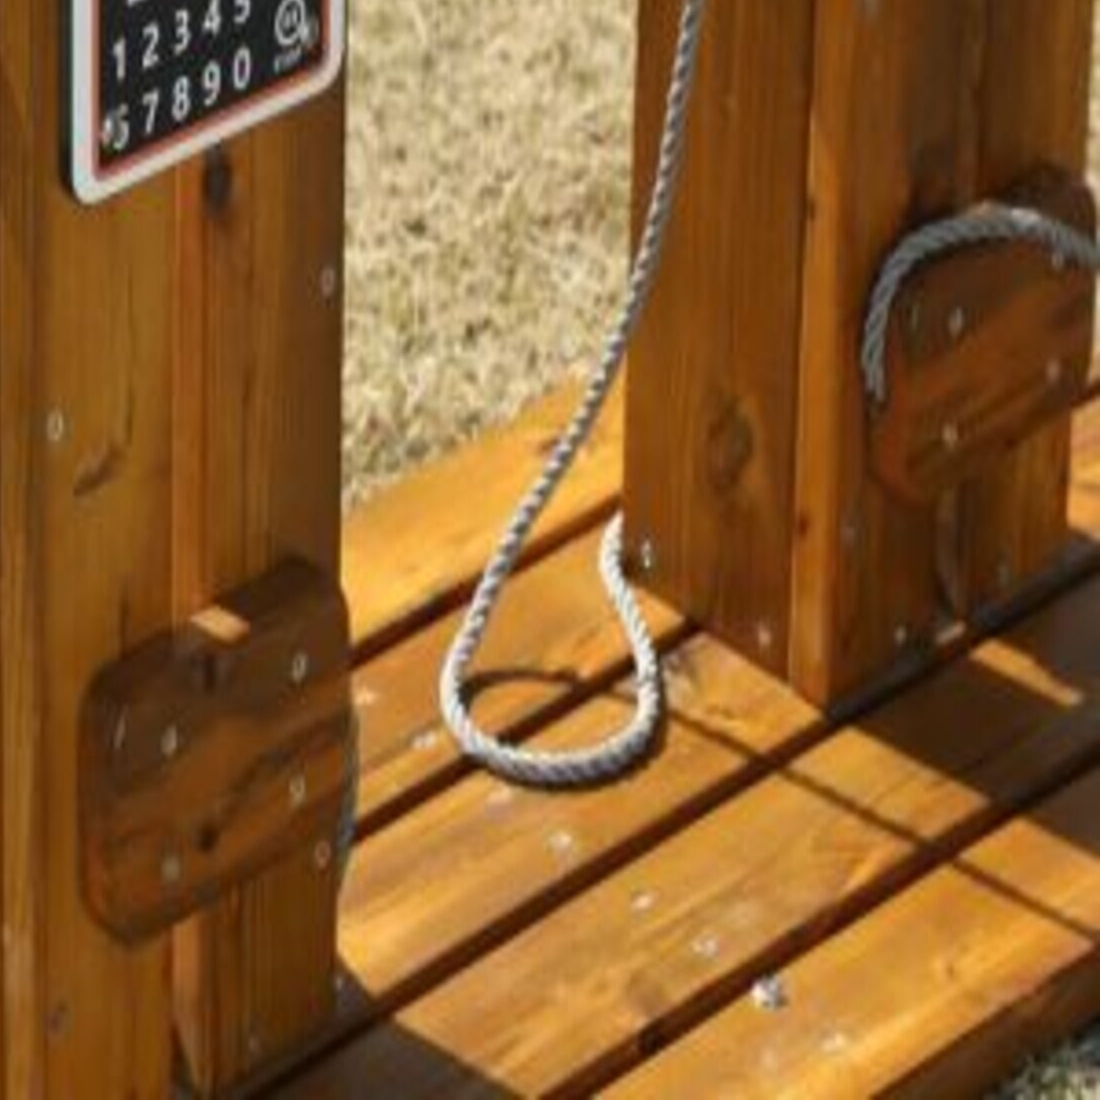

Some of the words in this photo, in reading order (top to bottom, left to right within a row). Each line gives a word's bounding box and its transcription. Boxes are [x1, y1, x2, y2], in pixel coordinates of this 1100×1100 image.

[113, 37, 126, 81] 1
[142, 22, 159, 69] 2
[175, 9, 191, 56] 3
[142, 89, 159, 134] 7
[172, 76, 191, 122] 8
[203, 61, 222, 107] 9
[233, 47, 251, 91] 0
